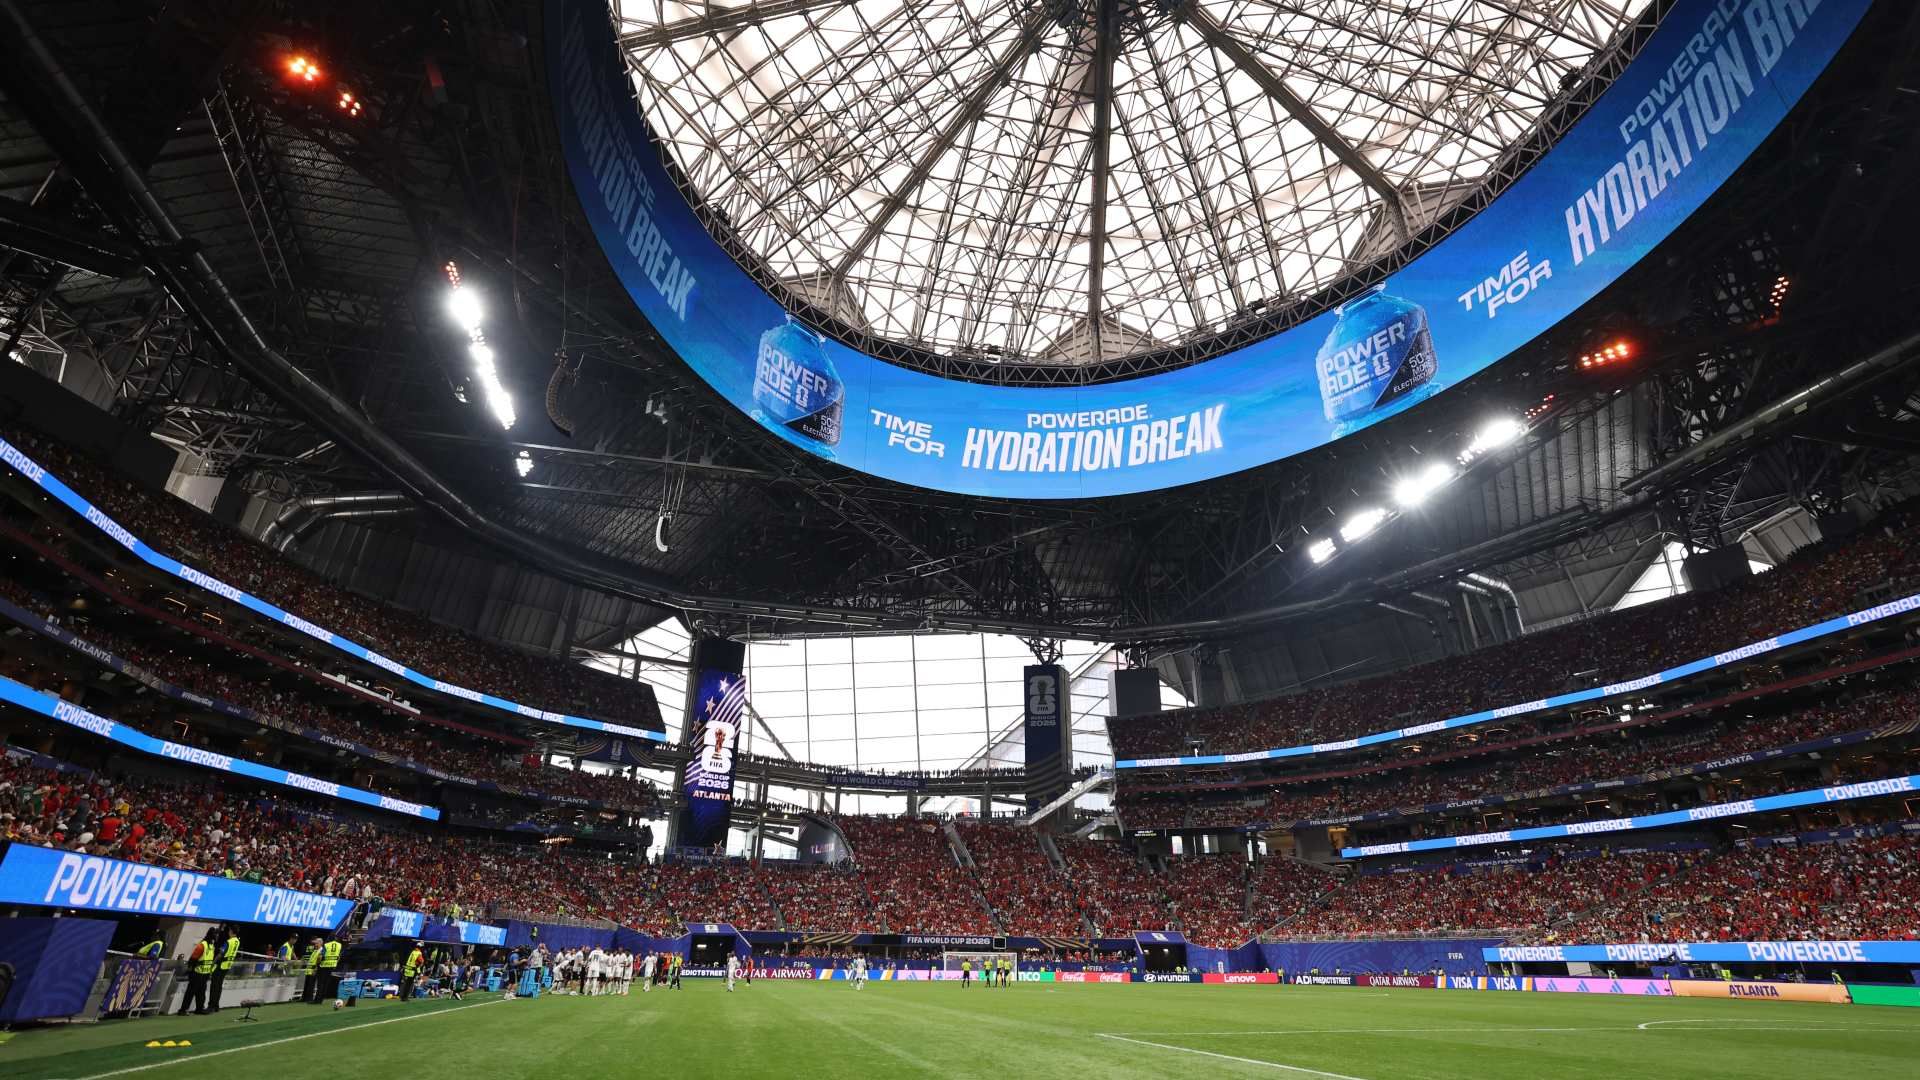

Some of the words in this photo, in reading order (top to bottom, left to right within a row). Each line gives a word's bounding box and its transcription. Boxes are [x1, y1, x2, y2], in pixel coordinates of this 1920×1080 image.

[1619, 0, 1742, 144] POWERAD
[1564, 29, 1754, 266] HYDRATION
[626, 208, 697, 321] BREAK
[1458, 250, 1530, 311] TIME
[1487, 258, 1553, 319] FOR
[1323, 321, 1406, 377] POWER
[760, 362, 792, 396] ADE
[764, 344, 828, 397] POWER
[1327, 361, 1370, 396] ADE
[870, 409, 933, 440] TIME
[1027, 404, 1148, 430] POWERADE
[888, 433, 945, 459] FOR
[961, 427, 1125, 473] HYDRATION
[1127, 404, 1225, 467] BREAK
[87, 505, 137, 550] POWERADE
[180, 565, 243, 601] POWERADE
[284, 613, 334, 643] POWERADE
[367, 650, 407, 676] POWERADE
[435, 681, 483, 702] POWERADE
[603, 723, 649, 738] POWERADE
[70, 637, 112, 664] ATLANTA
[1136, 758, 1181, 767] POWERADE
[1225, 751, 1271, 763] POWERADE
[1313, 738, 1360, 753] POWERADE
[1493, 700, 1549, 718] POWERADE
[1603, 672, 1663, 696] POWERADE
[1715, 637, 1780, 665] POWERADE
[1030, 719, 1057, 727] 2026
[319, 734, 355, 750] ATLANTA
[52, 701, 115, 738] POWERADE
[160, 741, 234, 770] POWERADE
[285, 772, 340, 796] POWERADE
[380, 797, 423, 815] POWERADE
[698, 778, 729, 790] 2026
[832, 775, 848, 784] FIFA
[850, 776, 876, 785] WORLD
[893, 779, 919, 787] 2026
[1446, 798, 1485, 809] ATLANTA
[1706, 754, 1754, 769] ATLANTA
[551, 795, 589, 805] ATLANTA
[693, 790, 731, 801] ATLANTA
[1456, 831, 1512, 847] POWERADE
[1566, 817, 1632, 835] POWERADE
[1689, 799, 1756, 820] POWERADE
[1823, 776, 1913, 801] POWERADE
[45, 853, 208, 915] POWERADE
[254, 886, 337, 927] POWERADE
[907, 936, 922, 944] FIFA
[924, 936, 949, 944] WORLD
[951, 937, 965, 945] CUP
[965, 937, 991, 945] 2026
[1500, 946, 1564, 961] POWERADE
[1747, 942, 1866, 961] POWERADE
[1448, 952, 1464, 961] FIFA
[770, 968, 812, 979] AIRWAYS
[1223, 974, 1257, 983] Lenovo
[1295, 975, 1313, 985] ADI
[1369, 976, 1391, 986] QATAR
[1392, 976, 1420, 987] AIRWAYS
[1451, 977, 1473, 990] VISA
[1492, 977, 1517, 991] VISA
[1729, 984, 1779, 997] ATLANTA
